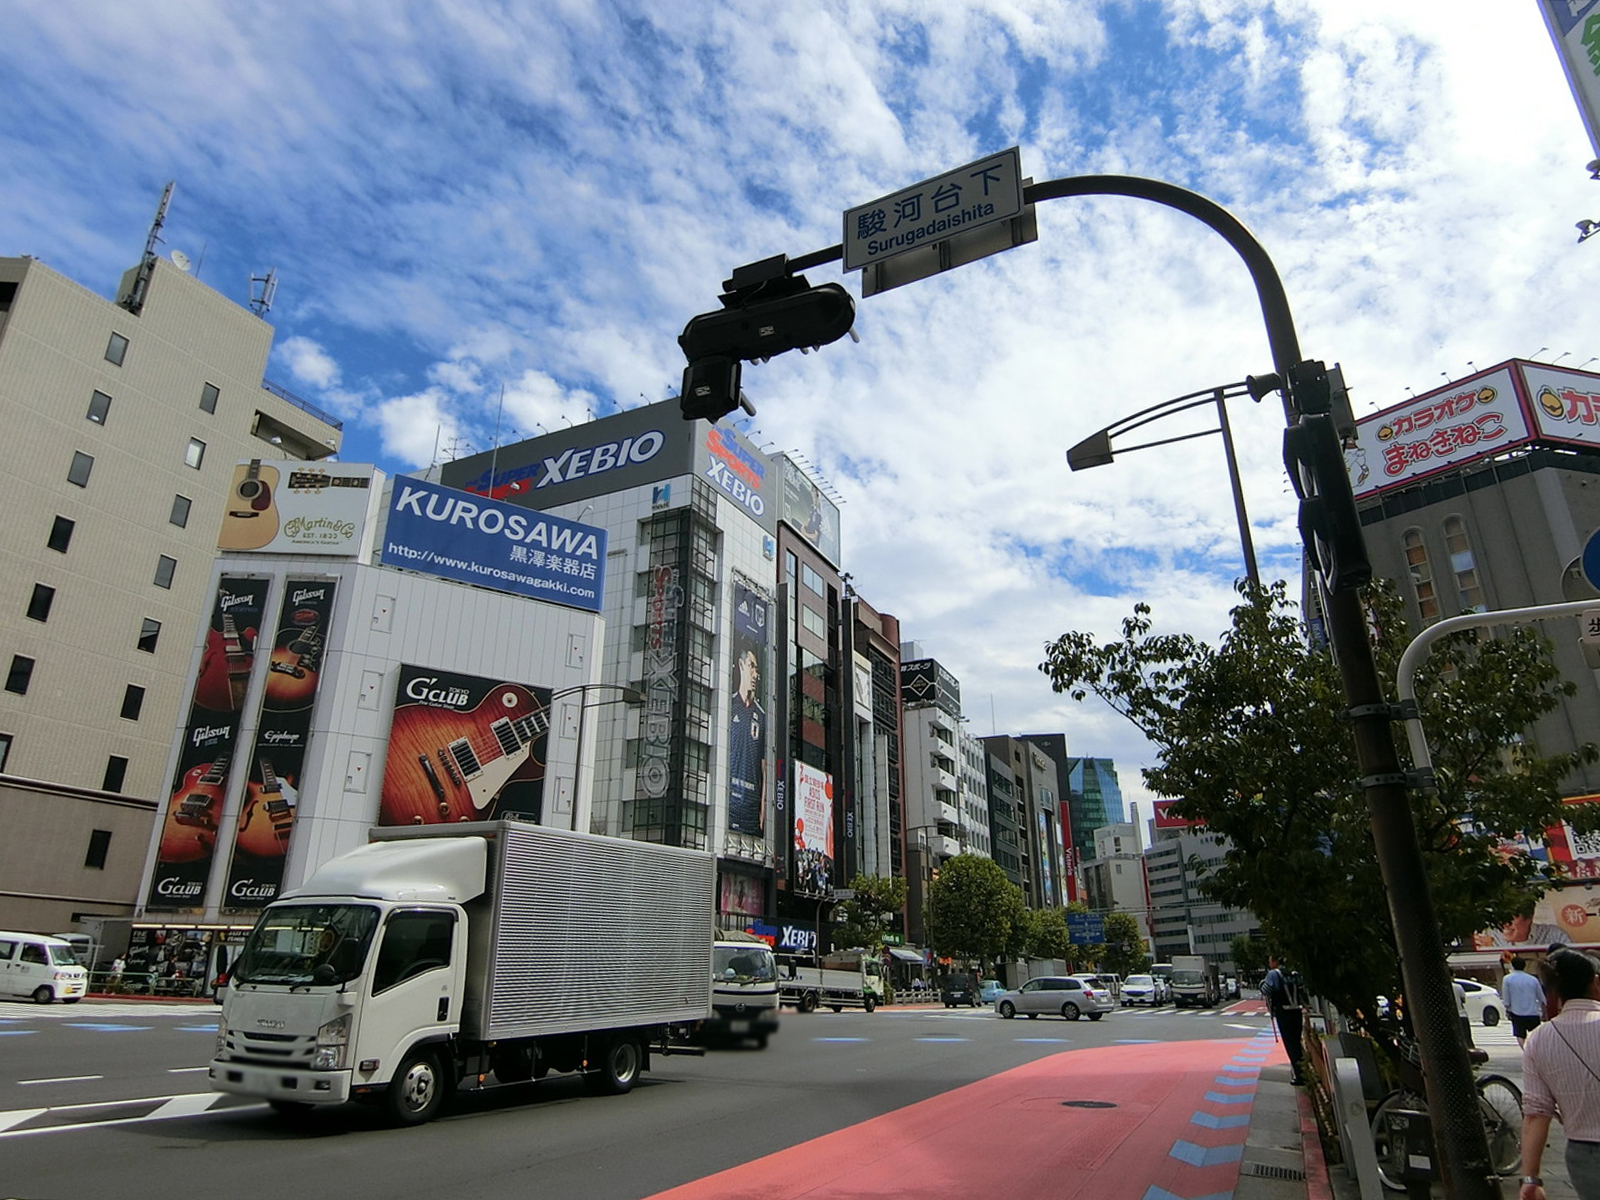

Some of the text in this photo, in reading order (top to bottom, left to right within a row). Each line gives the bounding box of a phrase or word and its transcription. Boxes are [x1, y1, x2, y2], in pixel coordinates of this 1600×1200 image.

[857, 164, 1003, 240] 駿河台下
[867, 203, 995, 256] Surugadaishita
[1392, 390, 1477, 437] カラオケ
[536, 430, 665, 490] XEBIO
[705, 429, 761, 490] SPORTS
[721, 427, 766, 480] SUPER
[1384, 412, 1507, 477] まねきねこ
[704, 453, 765, 516] XEBIO
[395, 486, 599, 560] KUROSAWA
[387, 541, 596, 599] http://www.kurosawagakki.com
[509, 544, 598, 581] 黒澤楽器店
[220, 594, 254, 612] Gibson
[292, 588, 325, 606] Gibson
[193, 725, 231, 747] Gibson
[264, 730, 300, 744] Epiphone
[640, 651, 679, 798] XEBIO
[776, 780, 785, 811] XEBIO
[846, 811, 854, 838] XEBIO
